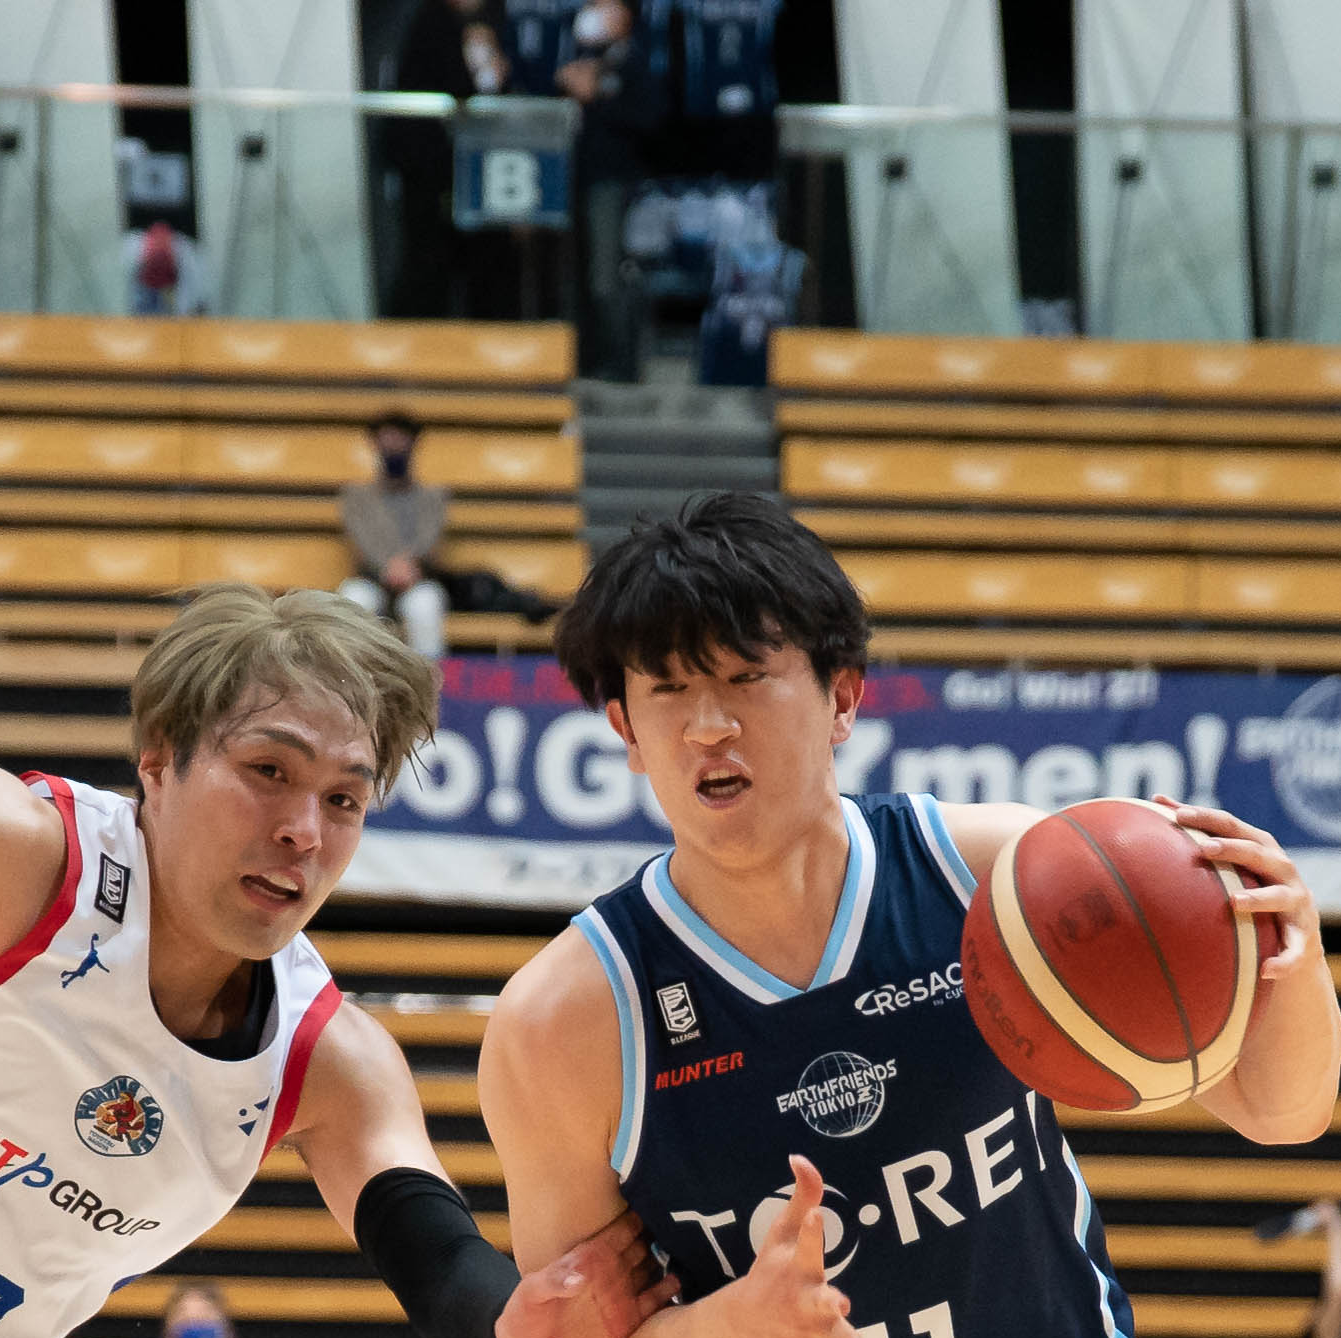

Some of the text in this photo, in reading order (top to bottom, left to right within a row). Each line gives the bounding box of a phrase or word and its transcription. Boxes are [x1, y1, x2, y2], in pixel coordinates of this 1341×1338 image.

[481, 149, 541, 217] B
[655, 1051, 744, 1091] MUNTER
[776, 1058, 898, 1113] EARTHFRIENDS
[808, 1091, 855, 1119] TOKYO
[49, 1180, 161, 1236] GROUP
